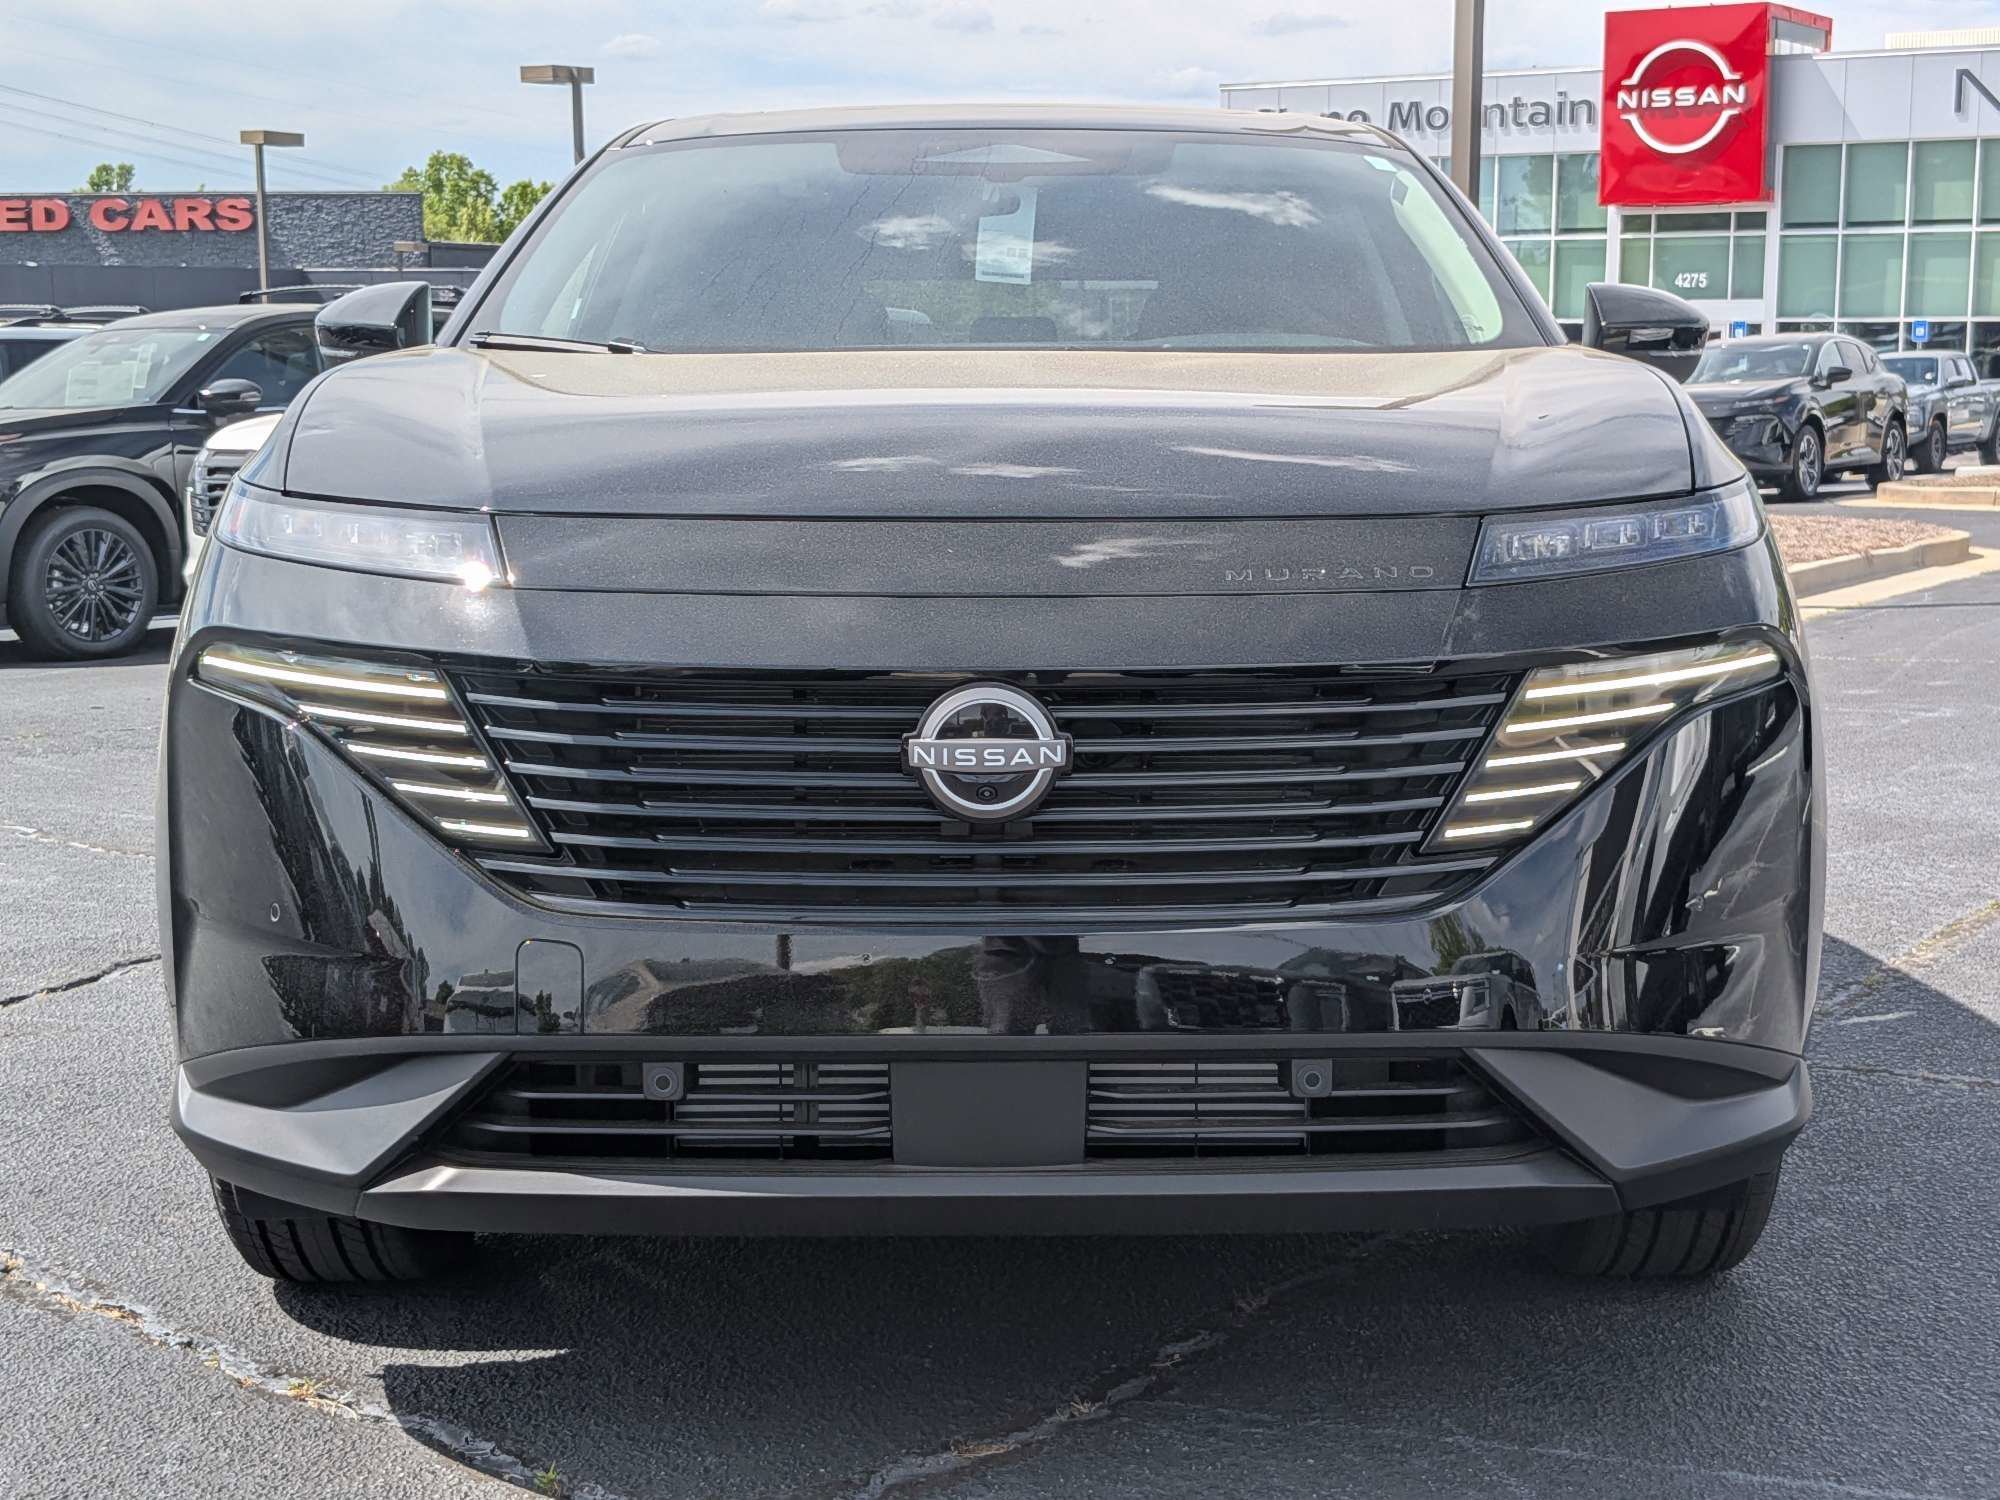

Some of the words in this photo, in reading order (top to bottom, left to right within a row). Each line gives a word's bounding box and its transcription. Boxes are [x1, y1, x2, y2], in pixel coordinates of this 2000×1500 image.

[1616, 85, 1746, 109] NISSAN
[1387, 91, 1596, 132] Montain
[89, 197, 253, 232] CARS
[1674, 271, 1709, 288] 4275
[1224, 566, 1433, 581] MURANO
[913, 745, 1062, 766] NISSAN
